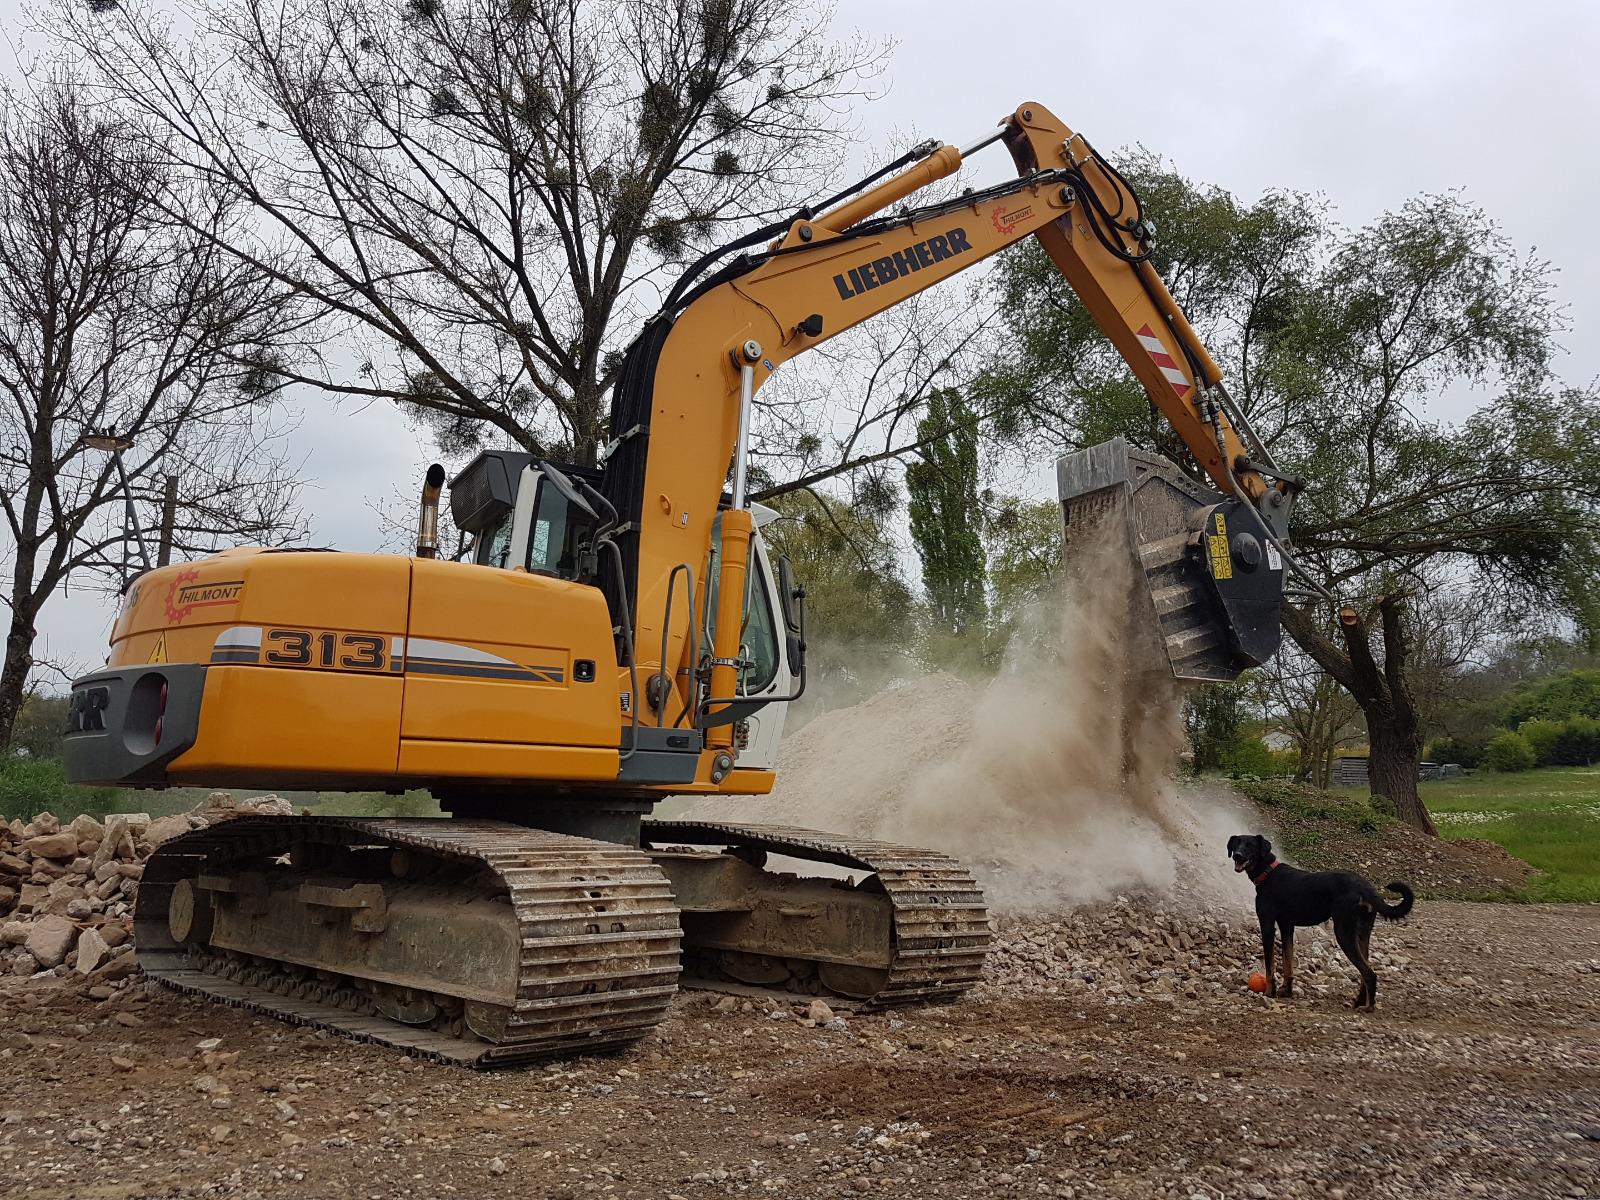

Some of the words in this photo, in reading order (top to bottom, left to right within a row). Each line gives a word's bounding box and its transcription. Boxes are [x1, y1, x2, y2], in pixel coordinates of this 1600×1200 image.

[832, 227, 973, 300] LIEBHERR
[178, 581, 244, 604] THILMONT
[266, 629, 386, 670] 313
